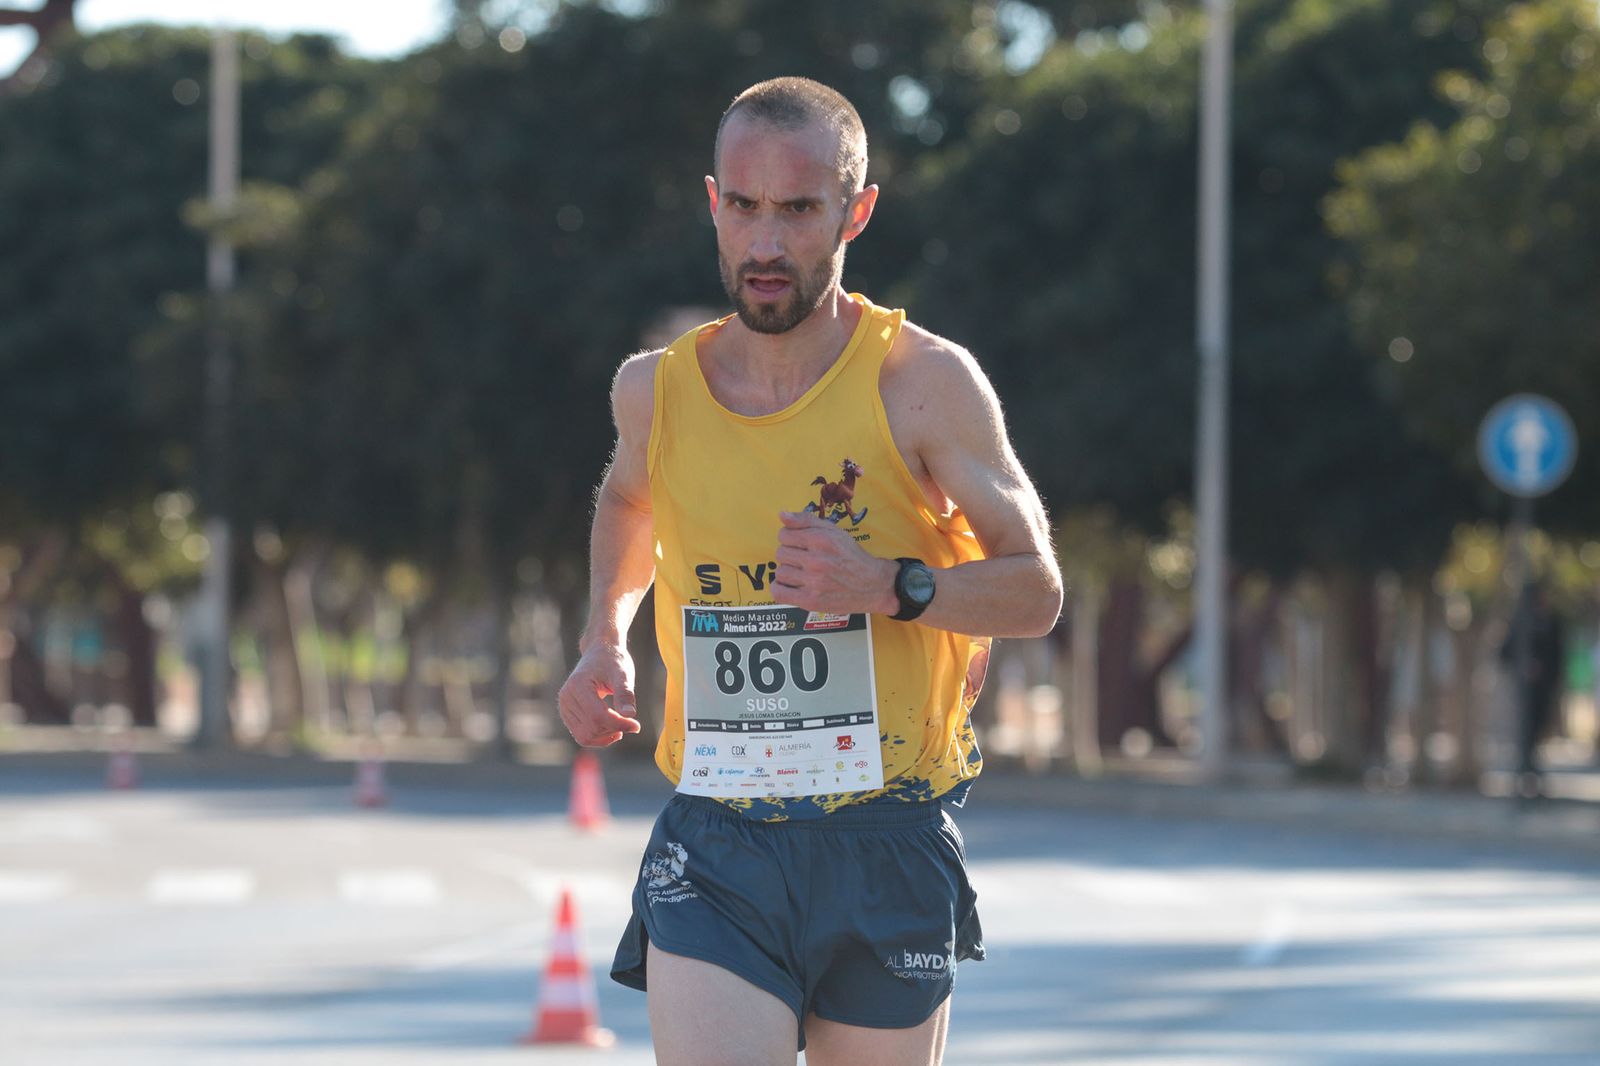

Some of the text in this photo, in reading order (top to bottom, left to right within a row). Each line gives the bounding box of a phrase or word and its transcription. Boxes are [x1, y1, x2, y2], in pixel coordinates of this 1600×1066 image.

[722, 612, 787, 623] Medio Maratón
[723, 622, 758, 633] Almería
[758, 621, 787, 632] 2022
[713, 636, 830, 695] 860
[746, 697, 789, 712] SUSO
[694, 746, 717, 756] NEXA
[854, 760, 868, 768] ego
[885, 955, 901, 969] AL
